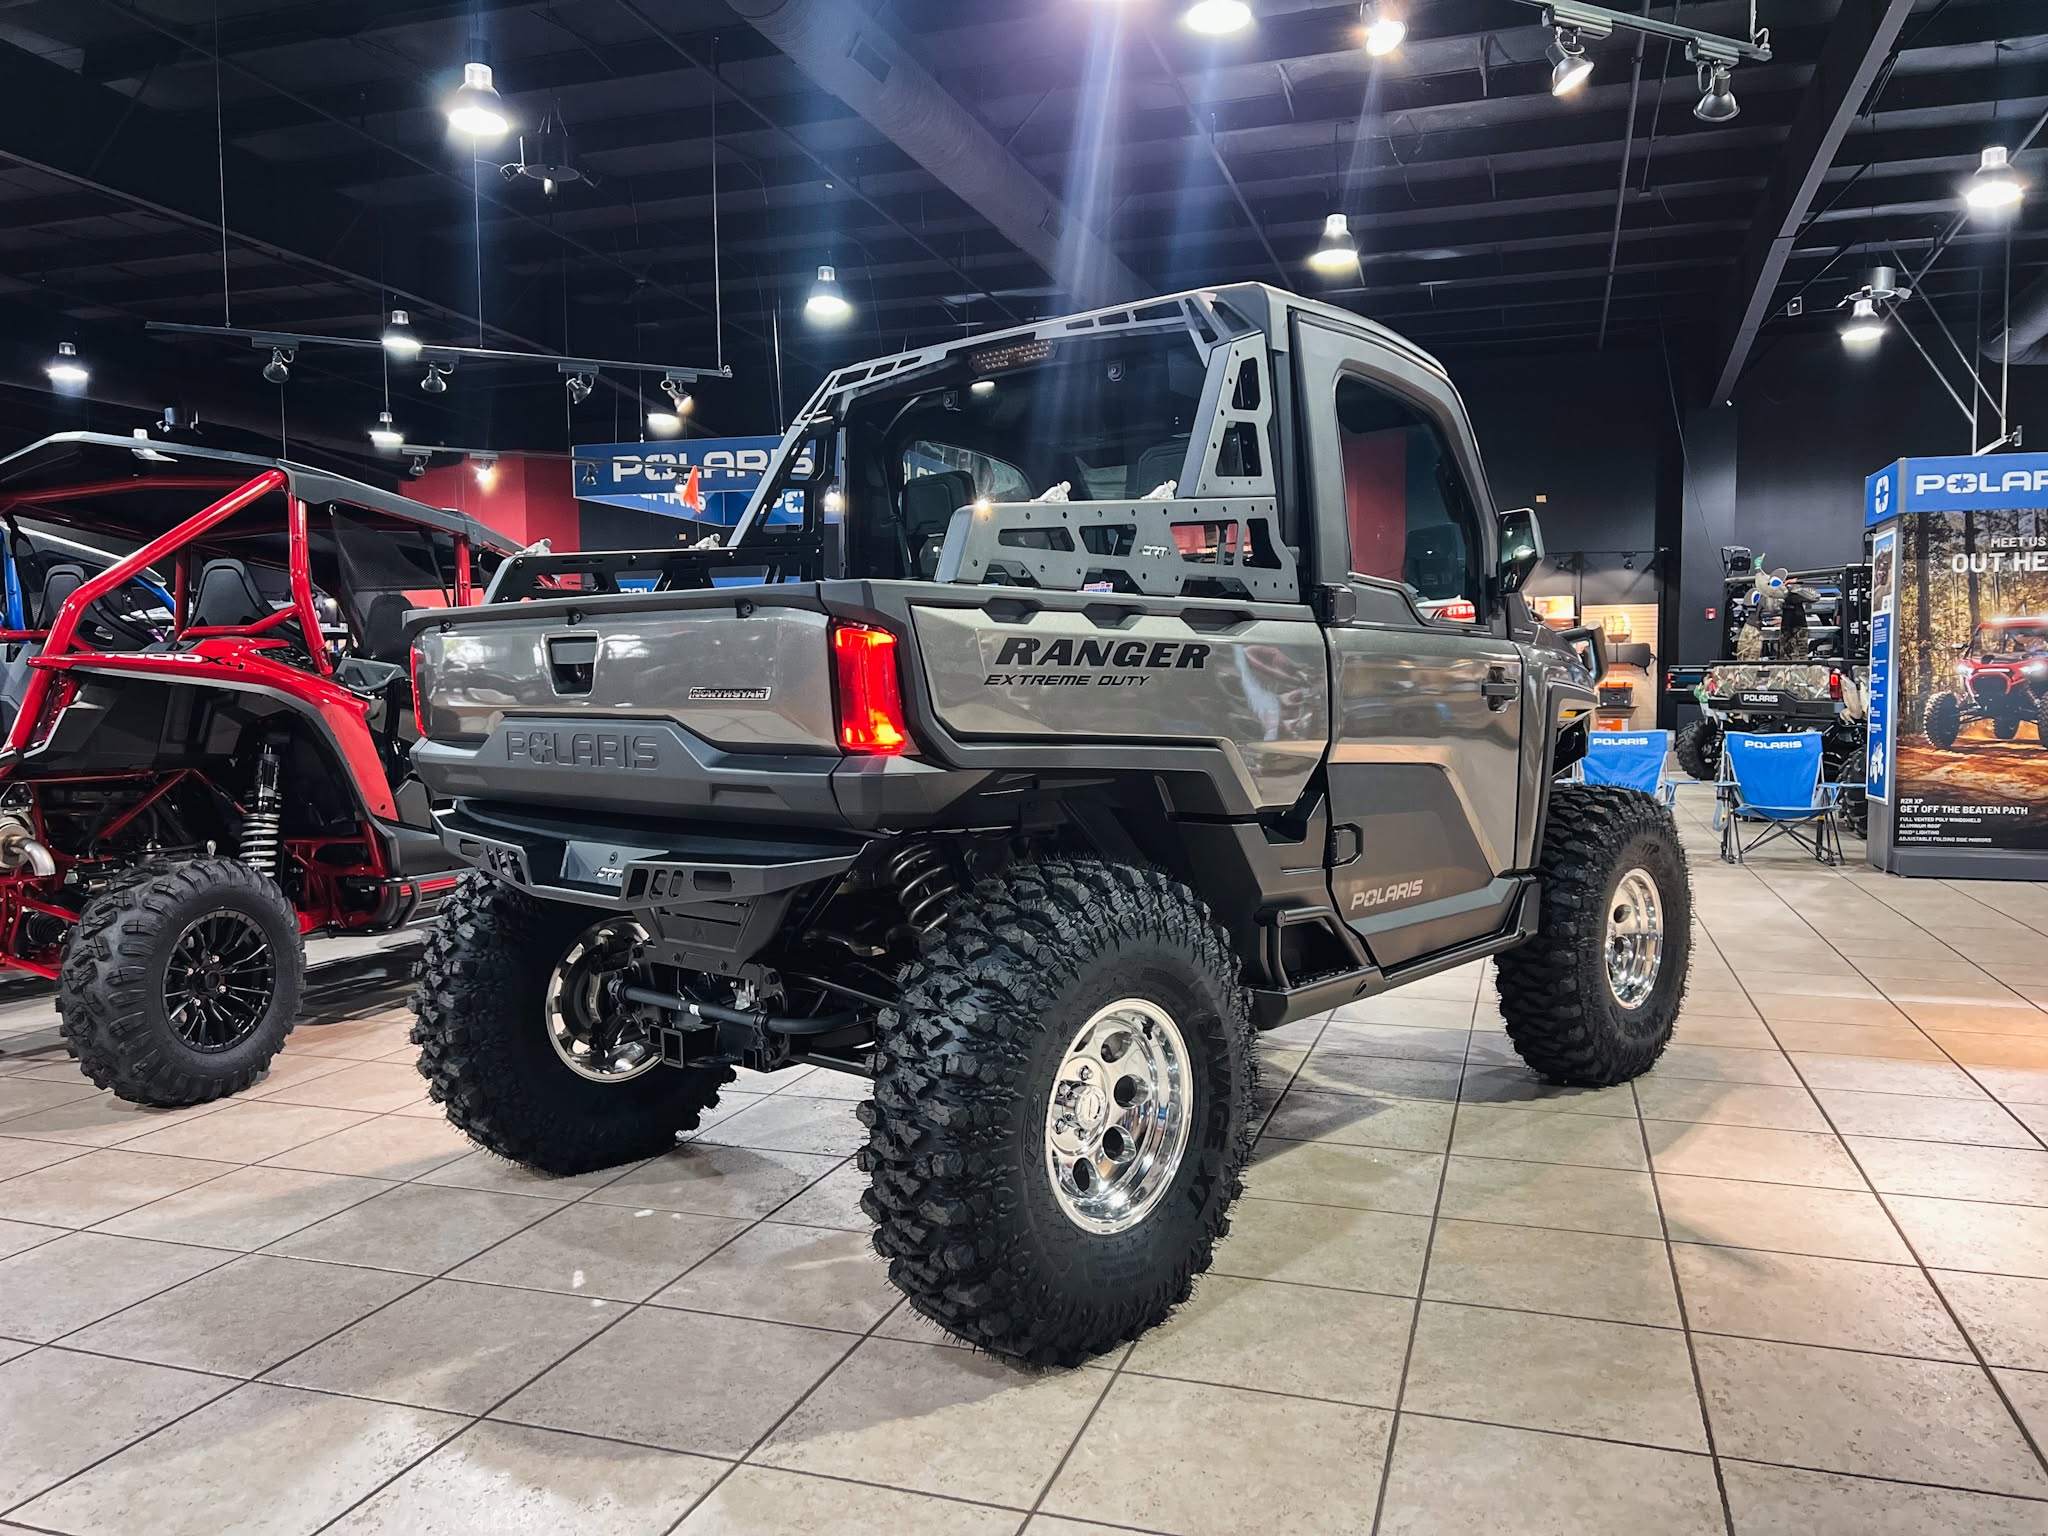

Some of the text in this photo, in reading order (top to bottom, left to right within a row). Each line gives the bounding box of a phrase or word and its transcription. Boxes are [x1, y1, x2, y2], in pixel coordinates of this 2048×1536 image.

[612, 445, 814, 483] POLARS
[1991, 536, 2047, 548] MEET US
[1951, 552, 2006, 574] OUT
[995, 637, 1212, 669] RANGER
[984, 674, 1152, 687] EXTREME DUTY
[690, 687, 767, 699] NORTHSTAR
[1743, 694, 1779, 703] POLARIS
[1592, 737, 1649, 746] POLARIS
[1744, 740, 1803, 749] POLARIS
[506, 731, 660, 770] POLARIS
[1900, 805, 2028, 815] GET OFF THE BEATEN PATH
[1350, 879, 1424, 911] POLARIS
